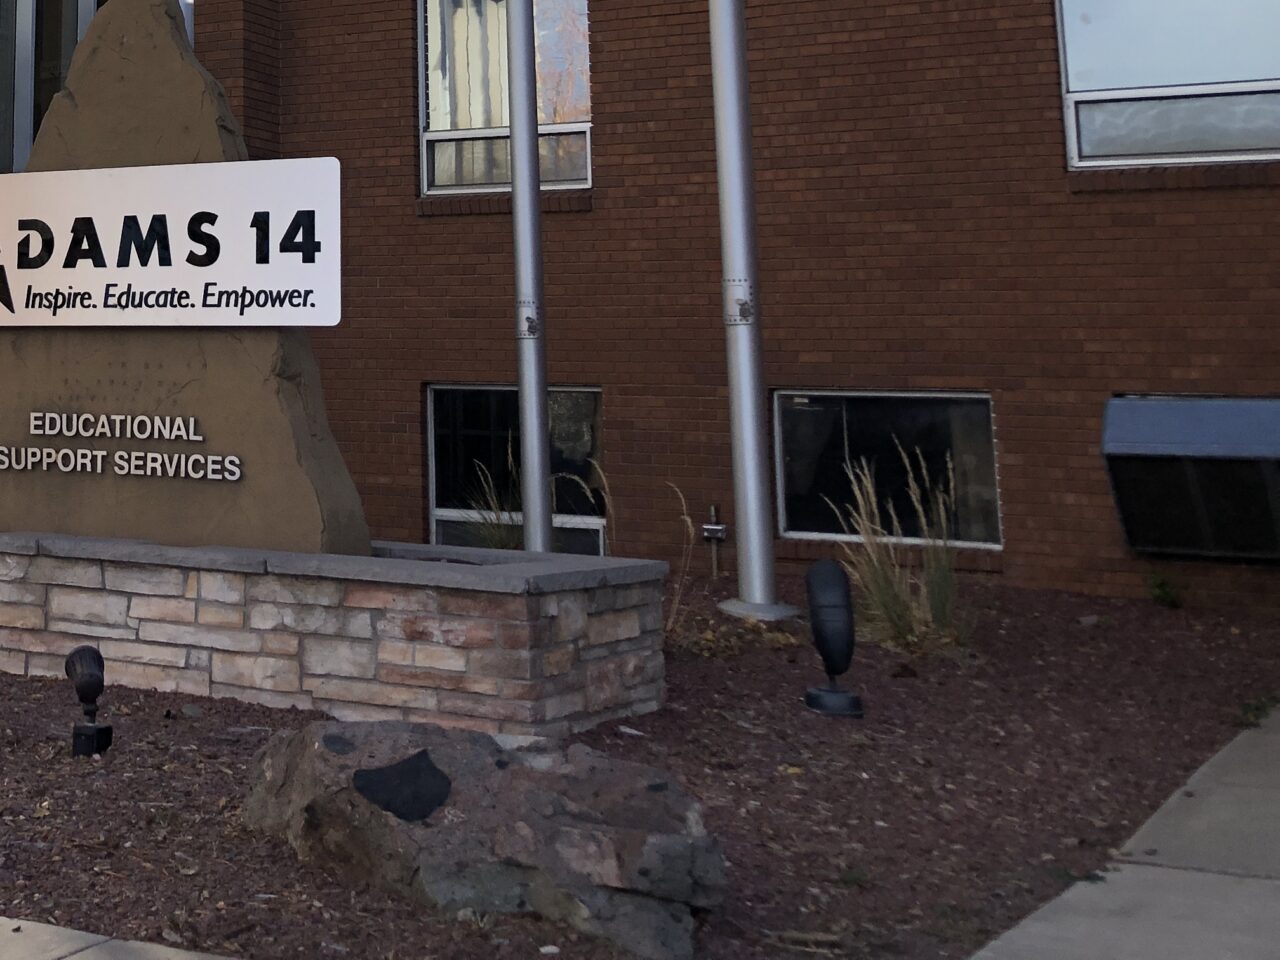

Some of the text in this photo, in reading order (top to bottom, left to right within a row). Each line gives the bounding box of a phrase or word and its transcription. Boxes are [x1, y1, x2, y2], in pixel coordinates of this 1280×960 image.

[249, 209, 321, 265] 14
[24, 282, 316, 316] Inspire. Educate. Empower.
[29, 412, 203, 441] EDUCATIONAL
[113, 451, 242, 481] SERVICES
